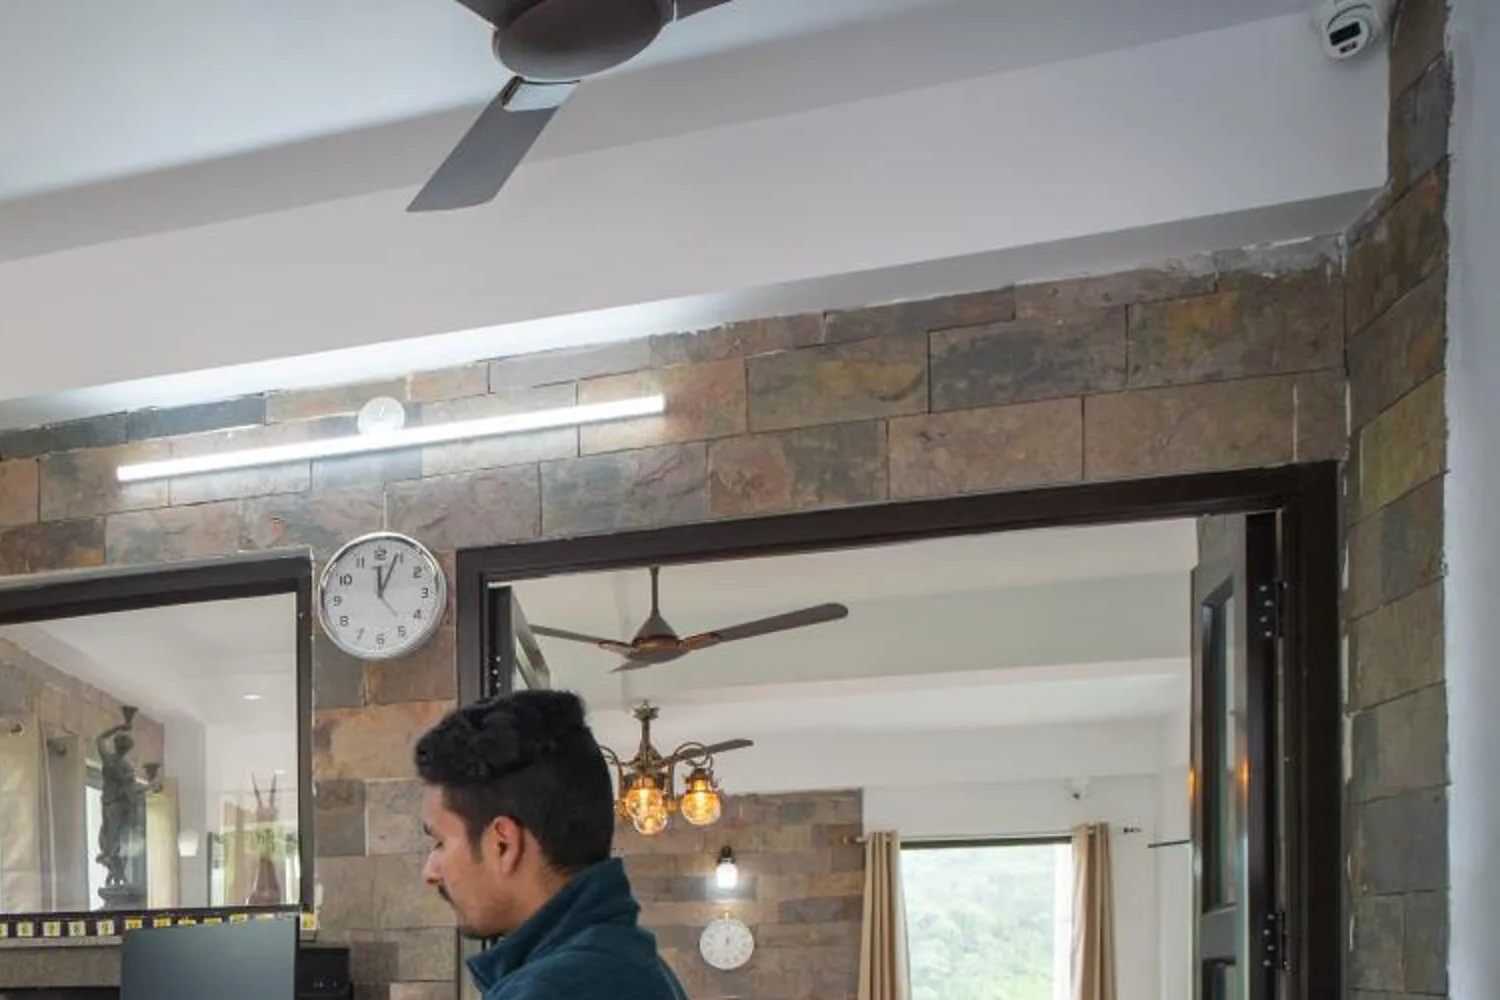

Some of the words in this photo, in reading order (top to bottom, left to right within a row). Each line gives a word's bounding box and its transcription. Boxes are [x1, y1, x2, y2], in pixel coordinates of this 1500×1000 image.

[374, 548, 388, 561] 12
[356, 557, 365, 568] 11
[413, 566, 422, 578] 2
[339, 574, 353, 586] 10
[421, 587, 429, 598] 3
[333, 596, 342, 606] 9
[413, 609, 421, 619] 4
[340, 616, 349, 627] 8
[357, 628, 365, 640] 7
[398, 626, 406, 637] 5
